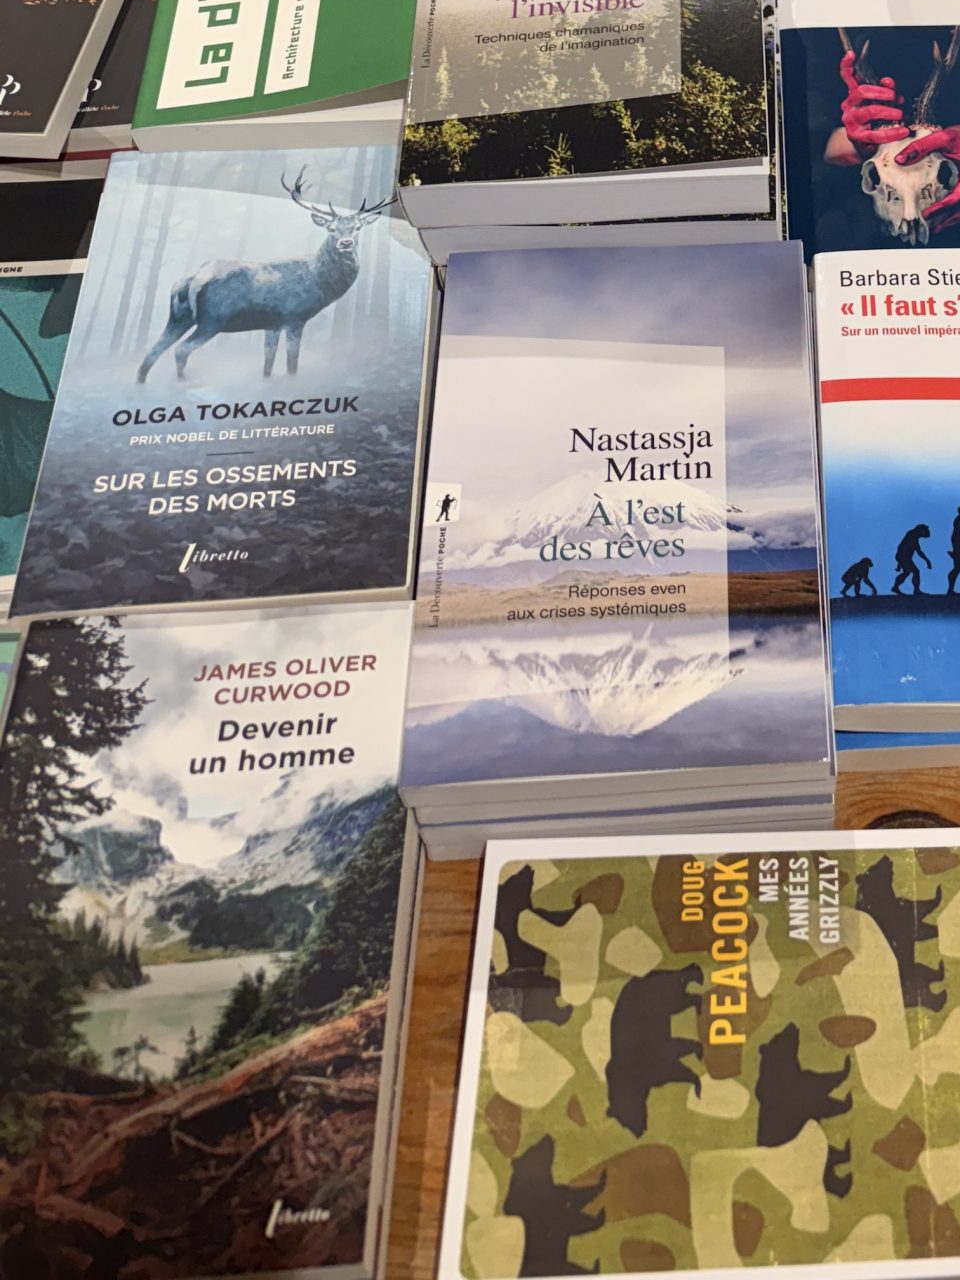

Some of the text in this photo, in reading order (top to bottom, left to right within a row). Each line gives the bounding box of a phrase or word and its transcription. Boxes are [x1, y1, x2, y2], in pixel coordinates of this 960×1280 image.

[474, 22, 645, 45] Techniques chamaniques
[184, 41, 234, 88] La
[840, 269, 920, 287] Barbara
[884, 294, 937, 317] faut
[841, 326, 861, 337] Sur
[882, 325, 921, 336] nouvel
[112, 396, 360, 426] OLGA TOKARCZUK
[129, 424, 335, 446] PRIX NOBEL LITTÉRATURE
[569, 423, 713, 458] Nastassja
[93, 459, 357, 493] SUR LES OSSEMENTS
[604, 452, 712, 483] Martin
[148, 489, 296, 516] DES MORTS
[539, 533, 686, 562] des rêves
[568, 583, 686, 601] Réponses even
[507, 601, 687, 621] aux crises systémiques
[193, 654, 377, 682] JAMES OLIVER
[214, 680, 351, 705] CURWOOD
[218, 713, 338, 742] Devenir
[238, 746, 355, 772] homme
[681, 860, 706, 922] DOUG
[758, 857, 779, 903] MES
[785, 856, 809, 940] ANNÉES
[819, 856, 840, 945] GRIZZLY
[708, 857, 749, 1045] PEACOCK
